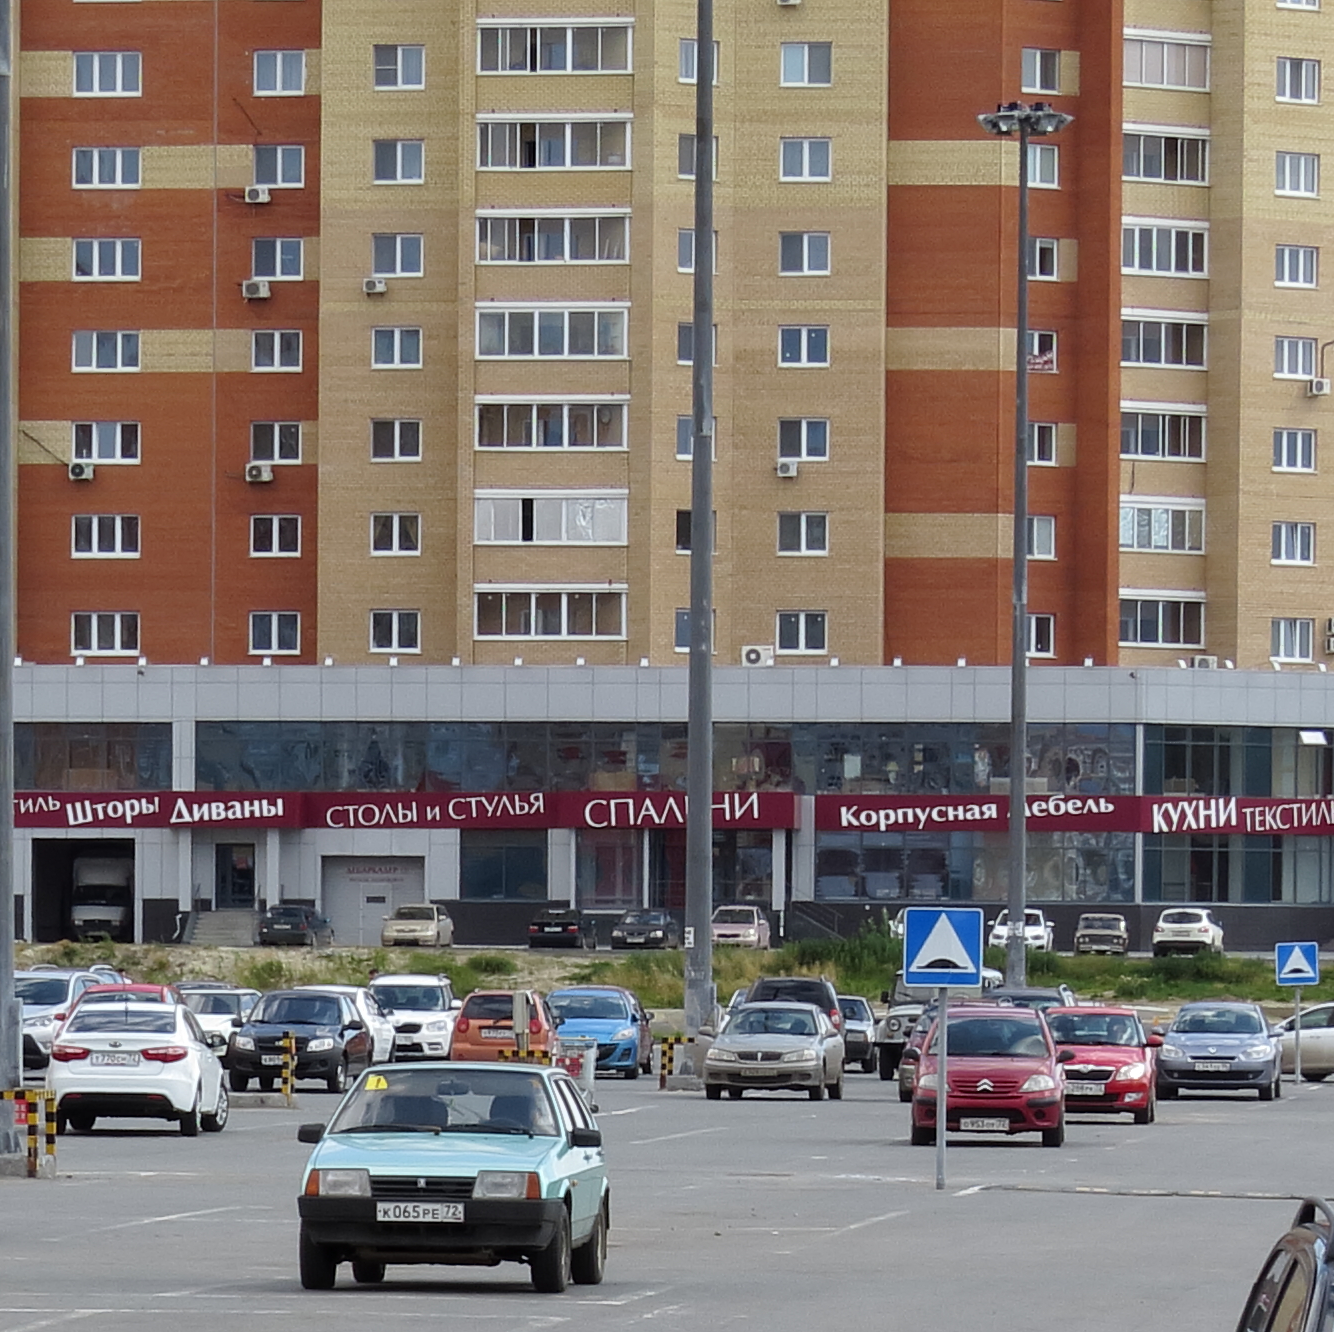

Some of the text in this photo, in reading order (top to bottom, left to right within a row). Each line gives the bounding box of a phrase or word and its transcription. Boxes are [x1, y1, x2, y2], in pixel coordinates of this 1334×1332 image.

[65, 796, 160, 826] Шторы
[170, 797, 285, 824] Диваны
[325, 801, 418, 828] СТОЛЫ
[448, 792, 545, 820] СТУЛЬЯ
[584, 792, 759, 828] СПАЛНИ
[840, 803, 998, 831] Корпусная
[1152, 797, 1237, 833] КУХНИ
[382, 1204, 459, 1220] К065РЕ 72
